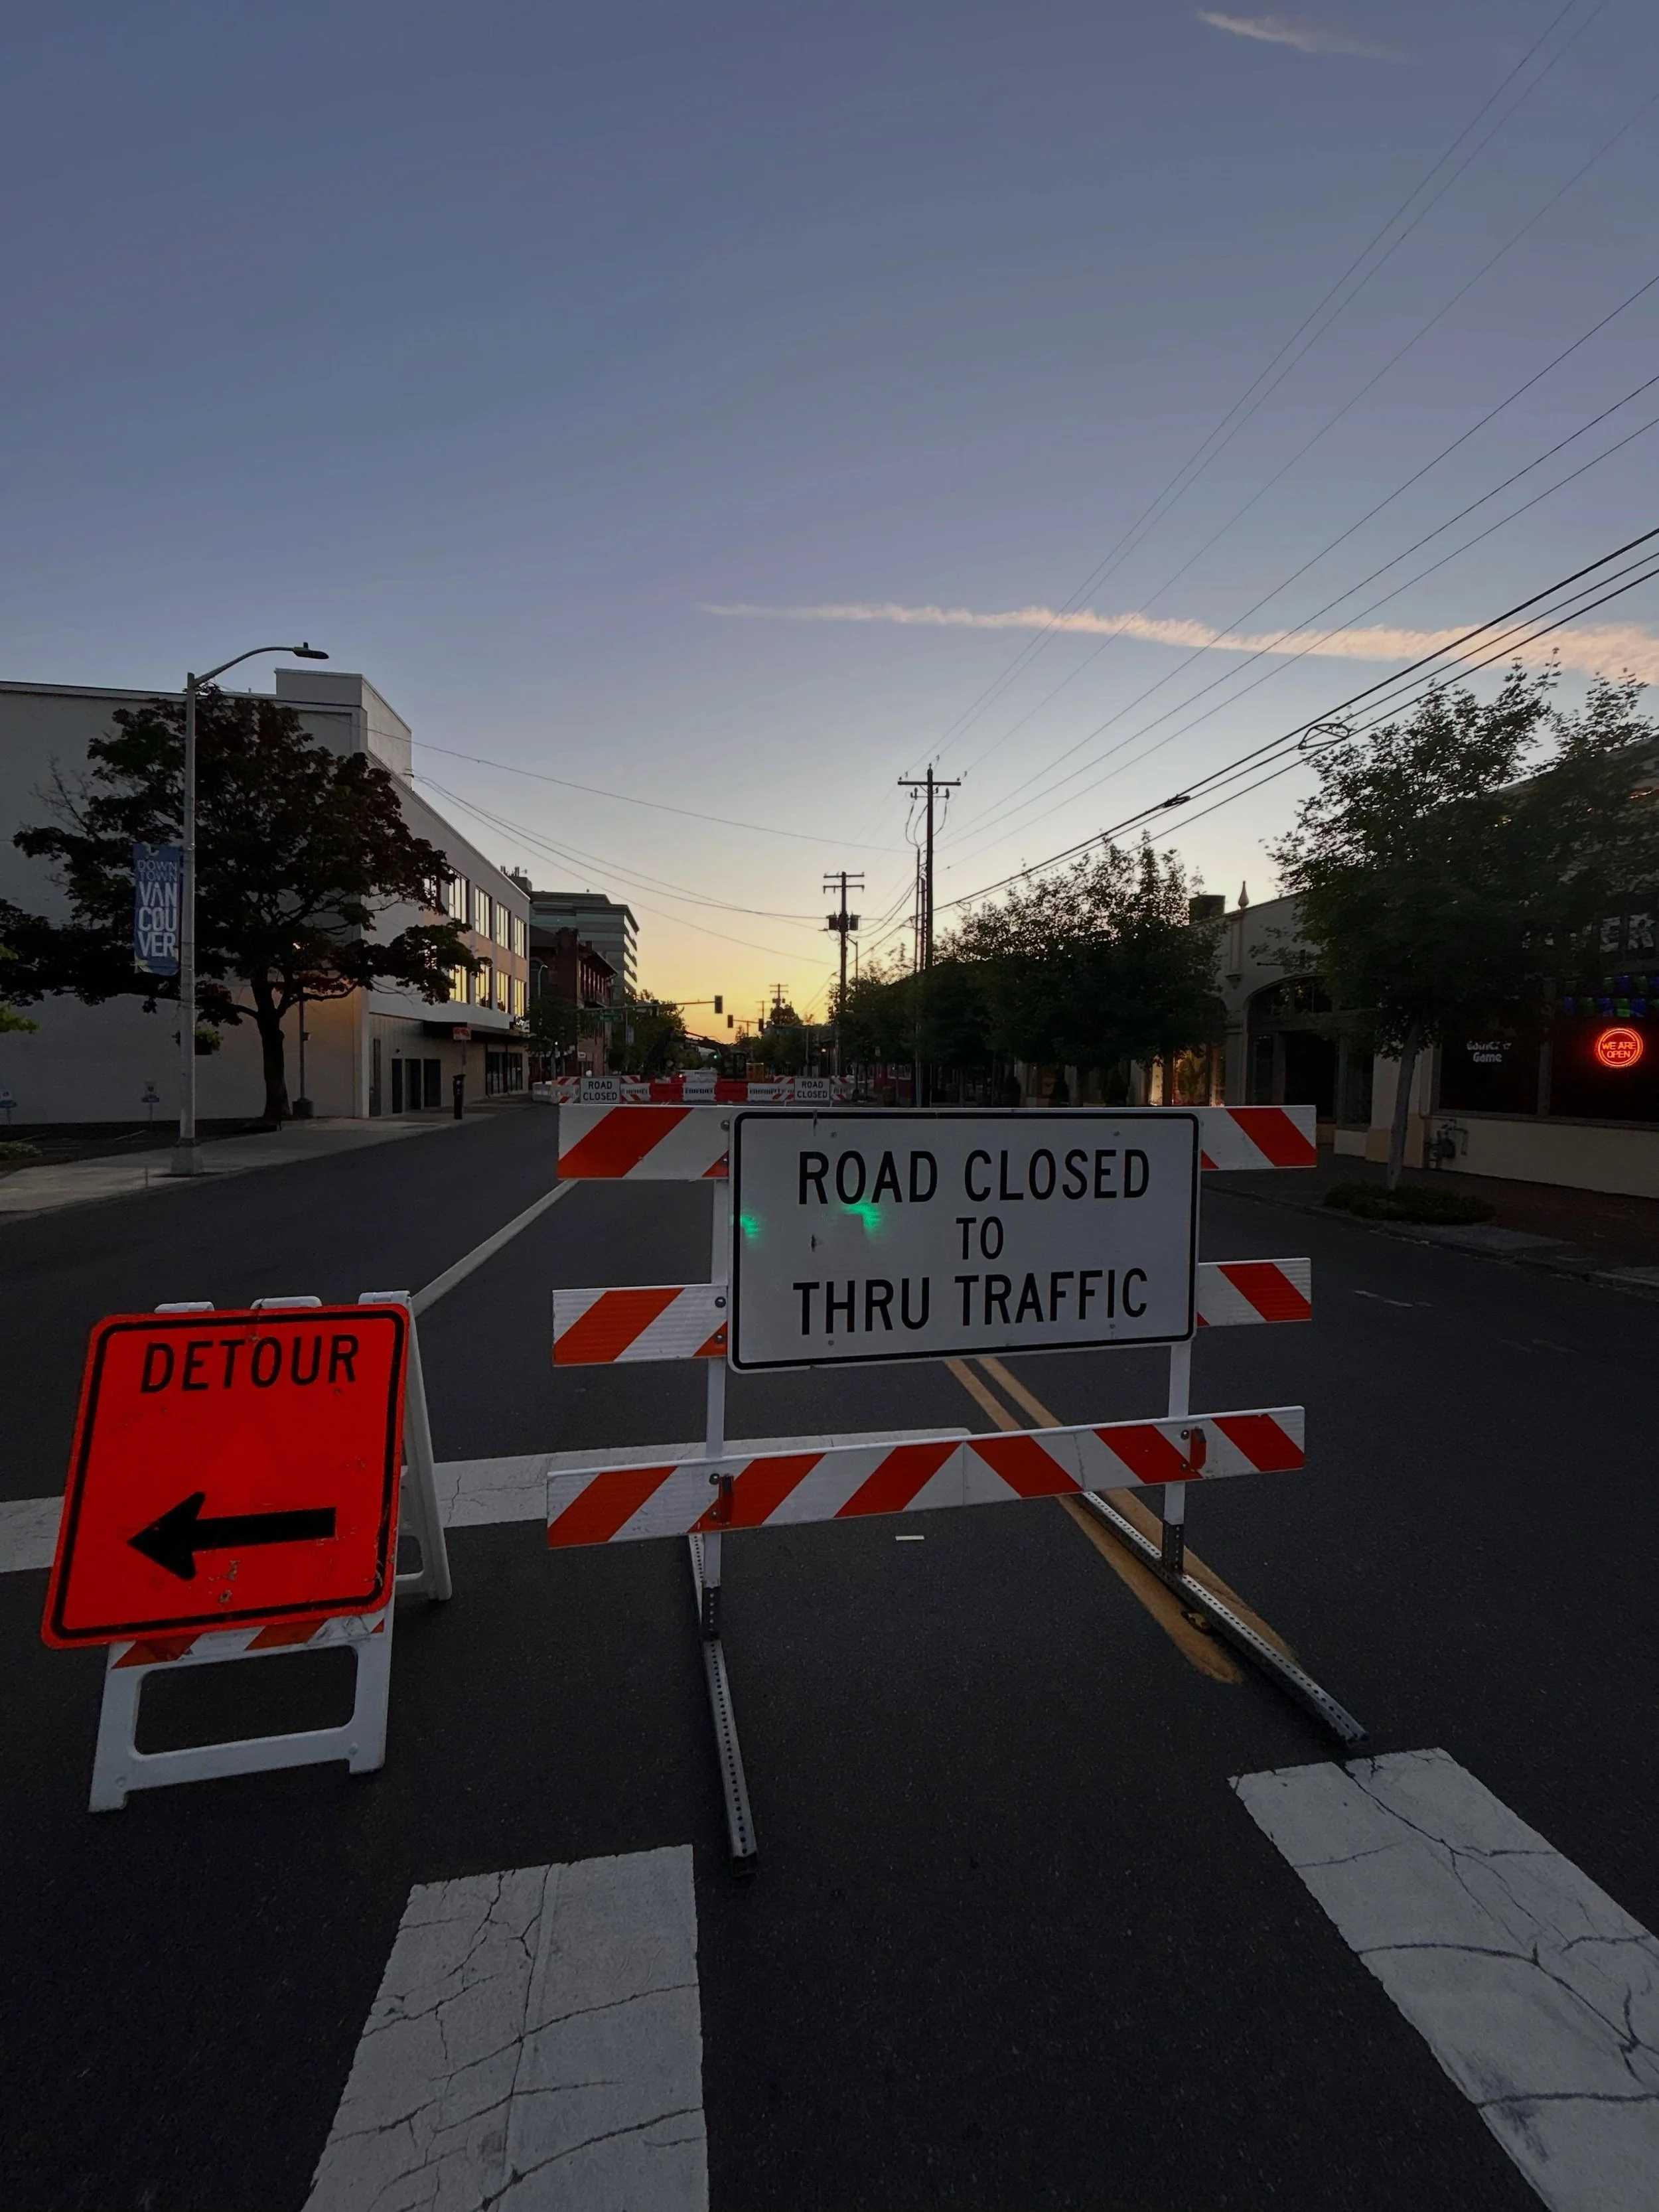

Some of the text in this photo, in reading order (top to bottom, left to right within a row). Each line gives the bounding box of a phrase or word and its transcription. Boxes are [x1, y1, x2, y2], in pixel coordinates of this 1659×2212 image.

[137, 860, 177, 871] DOWN
[140, 871, 177, 881] TOWN
[139, 882, 177, 907] VAN
[138, 907, 177, 931] COU
[138, 932, 176, 957] VER
[1602, 1041, 1617, 1050] WE
[799, 1149, 1149, 1205] ROAD CLOSED
[956, 1217, 1003, 1260] TO
[793, 1268, 1148, 1335] THRU TRAFFIC
[141, 1335, 359, 1394] DETOUR
